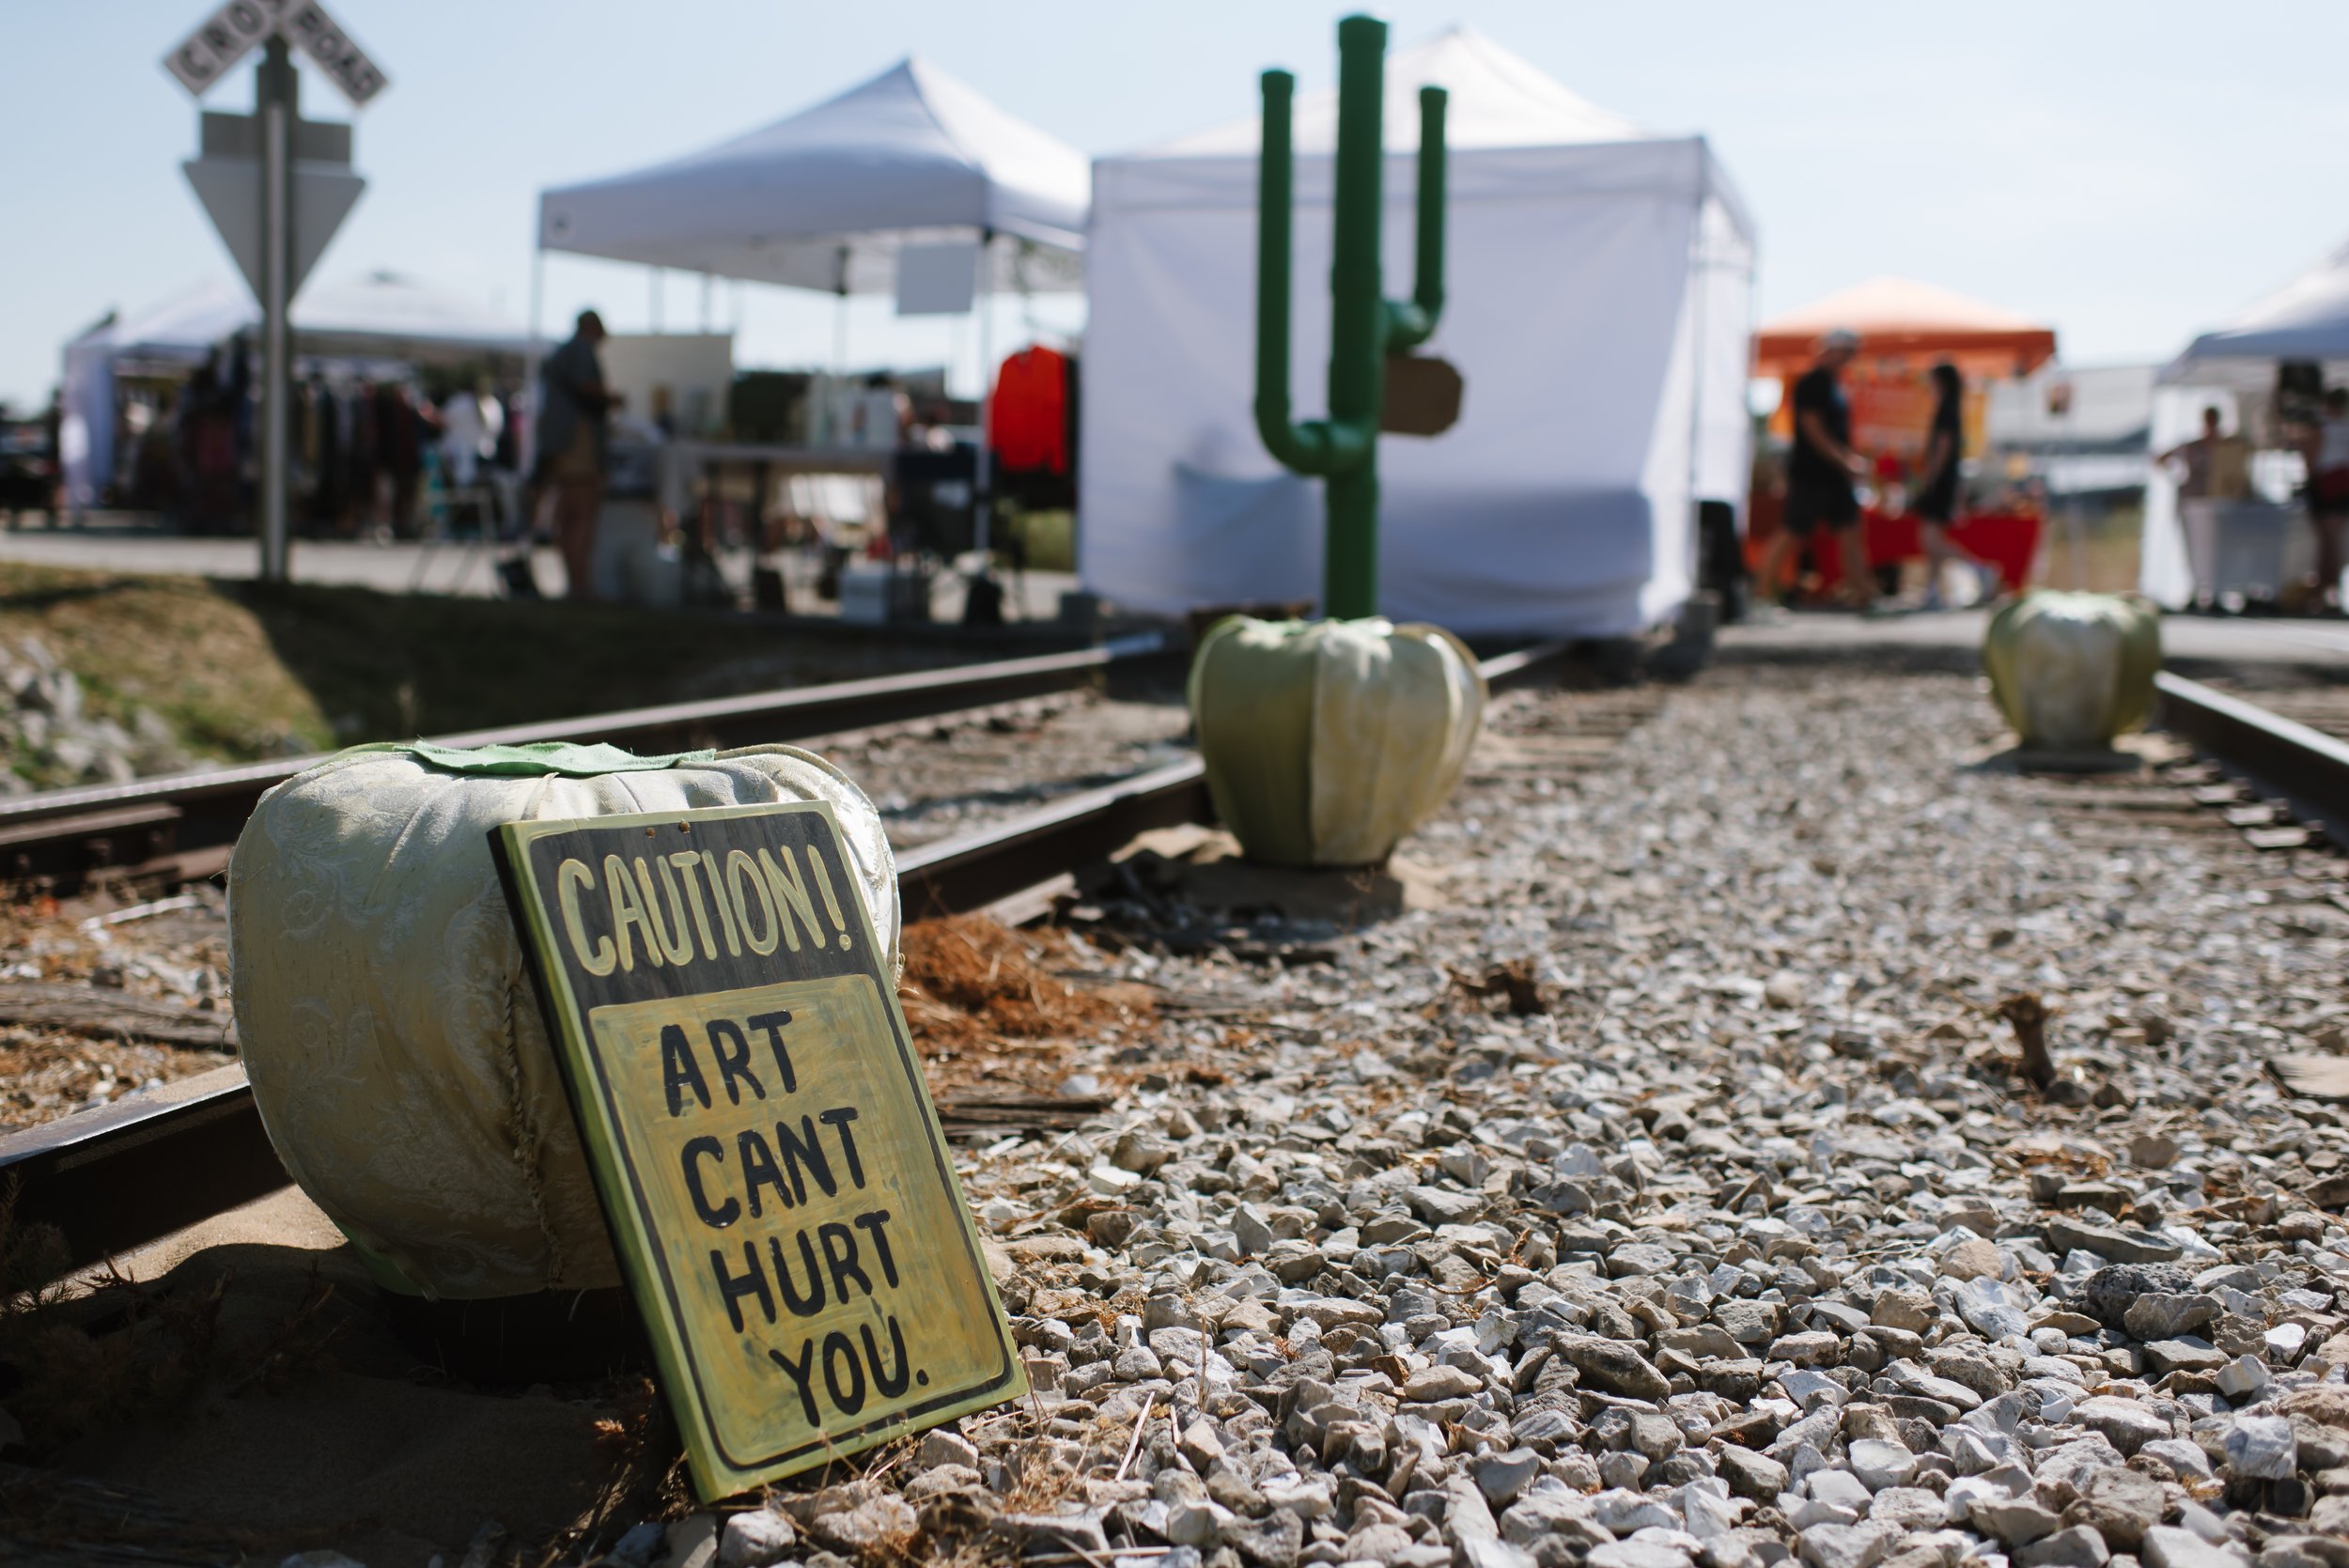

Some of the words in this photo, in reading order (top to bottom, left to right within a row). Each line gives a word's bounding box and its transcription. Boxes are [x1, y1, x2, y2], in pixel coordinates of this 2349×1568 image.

[557, 845, 852, 976] CAUTION!
[661, 1010, 797, 1117] ART
[680, 1107, 867, 1229] CANT
[710, 1209, 900, 1333] HURT
[770, 1315, 929, 1427] YOU.
